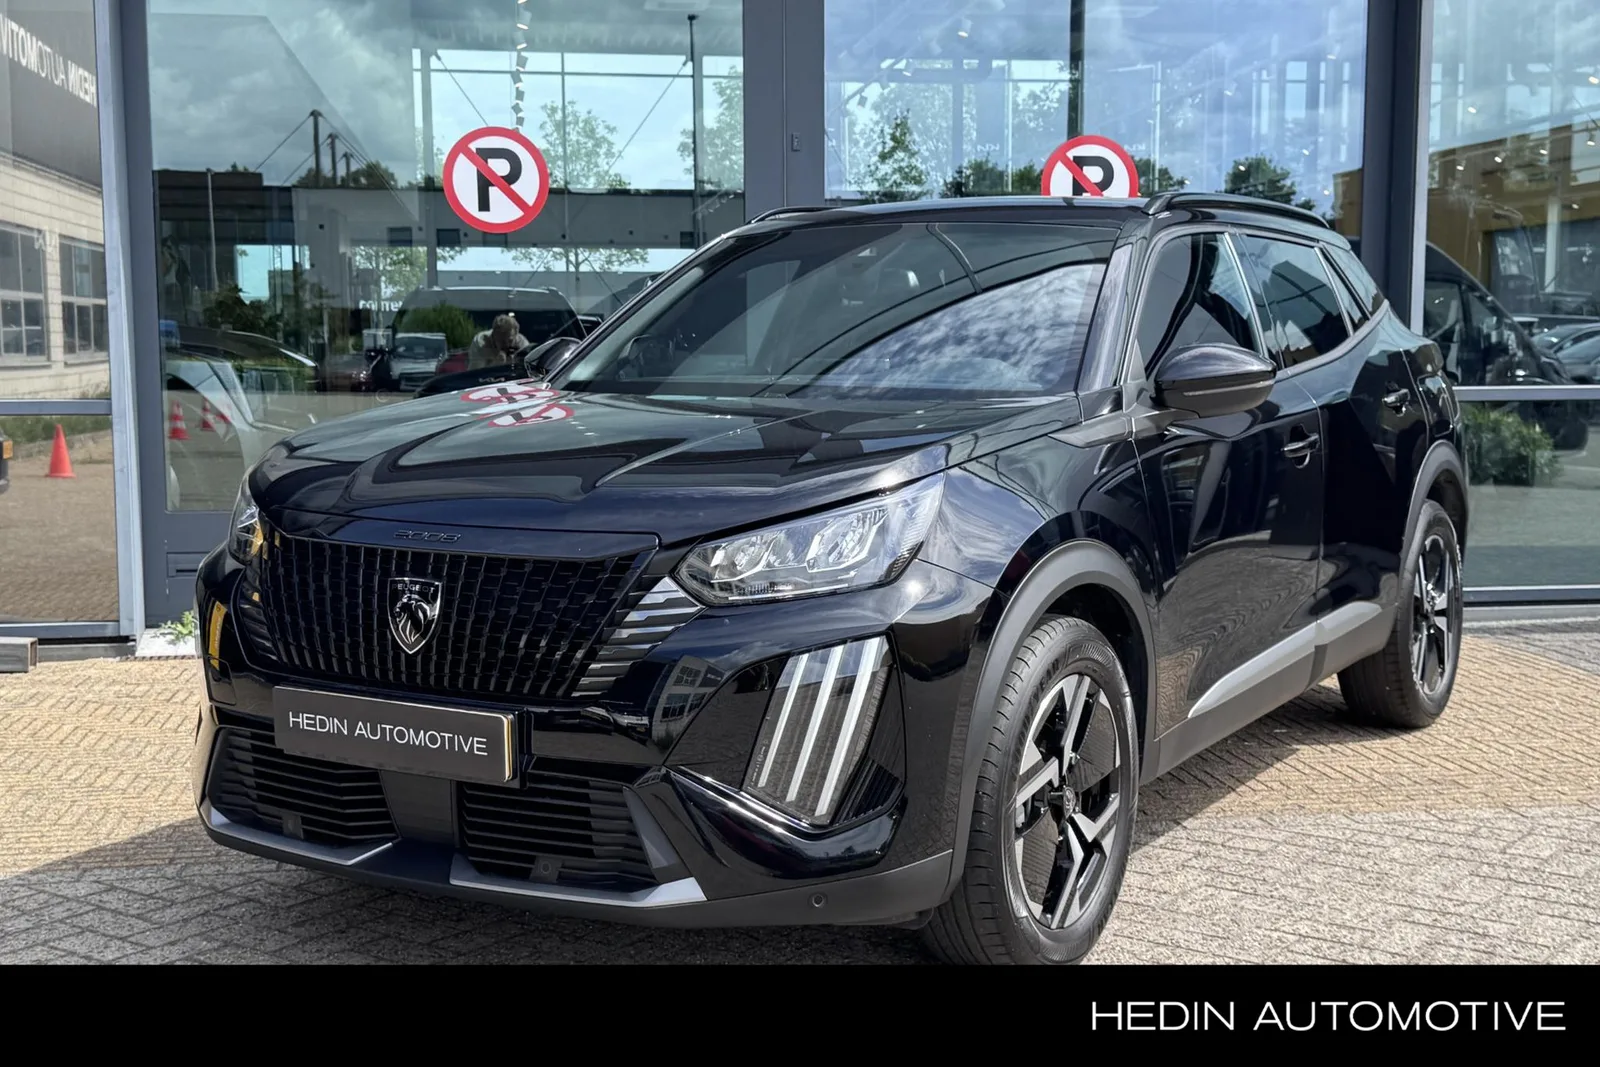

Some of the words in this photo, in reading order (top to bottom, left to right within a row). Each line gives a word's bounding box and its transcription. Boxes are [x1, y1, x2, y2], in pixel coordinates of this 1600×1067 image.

[475, 147, 523, 212] P
[393, 529, 462, 544] 2008
[392, 582, 435, 594] PEUGEOT
[288, 711, 348, 736] HEDIN
[354, 720, 489, 756] AUTOMOTIVE
